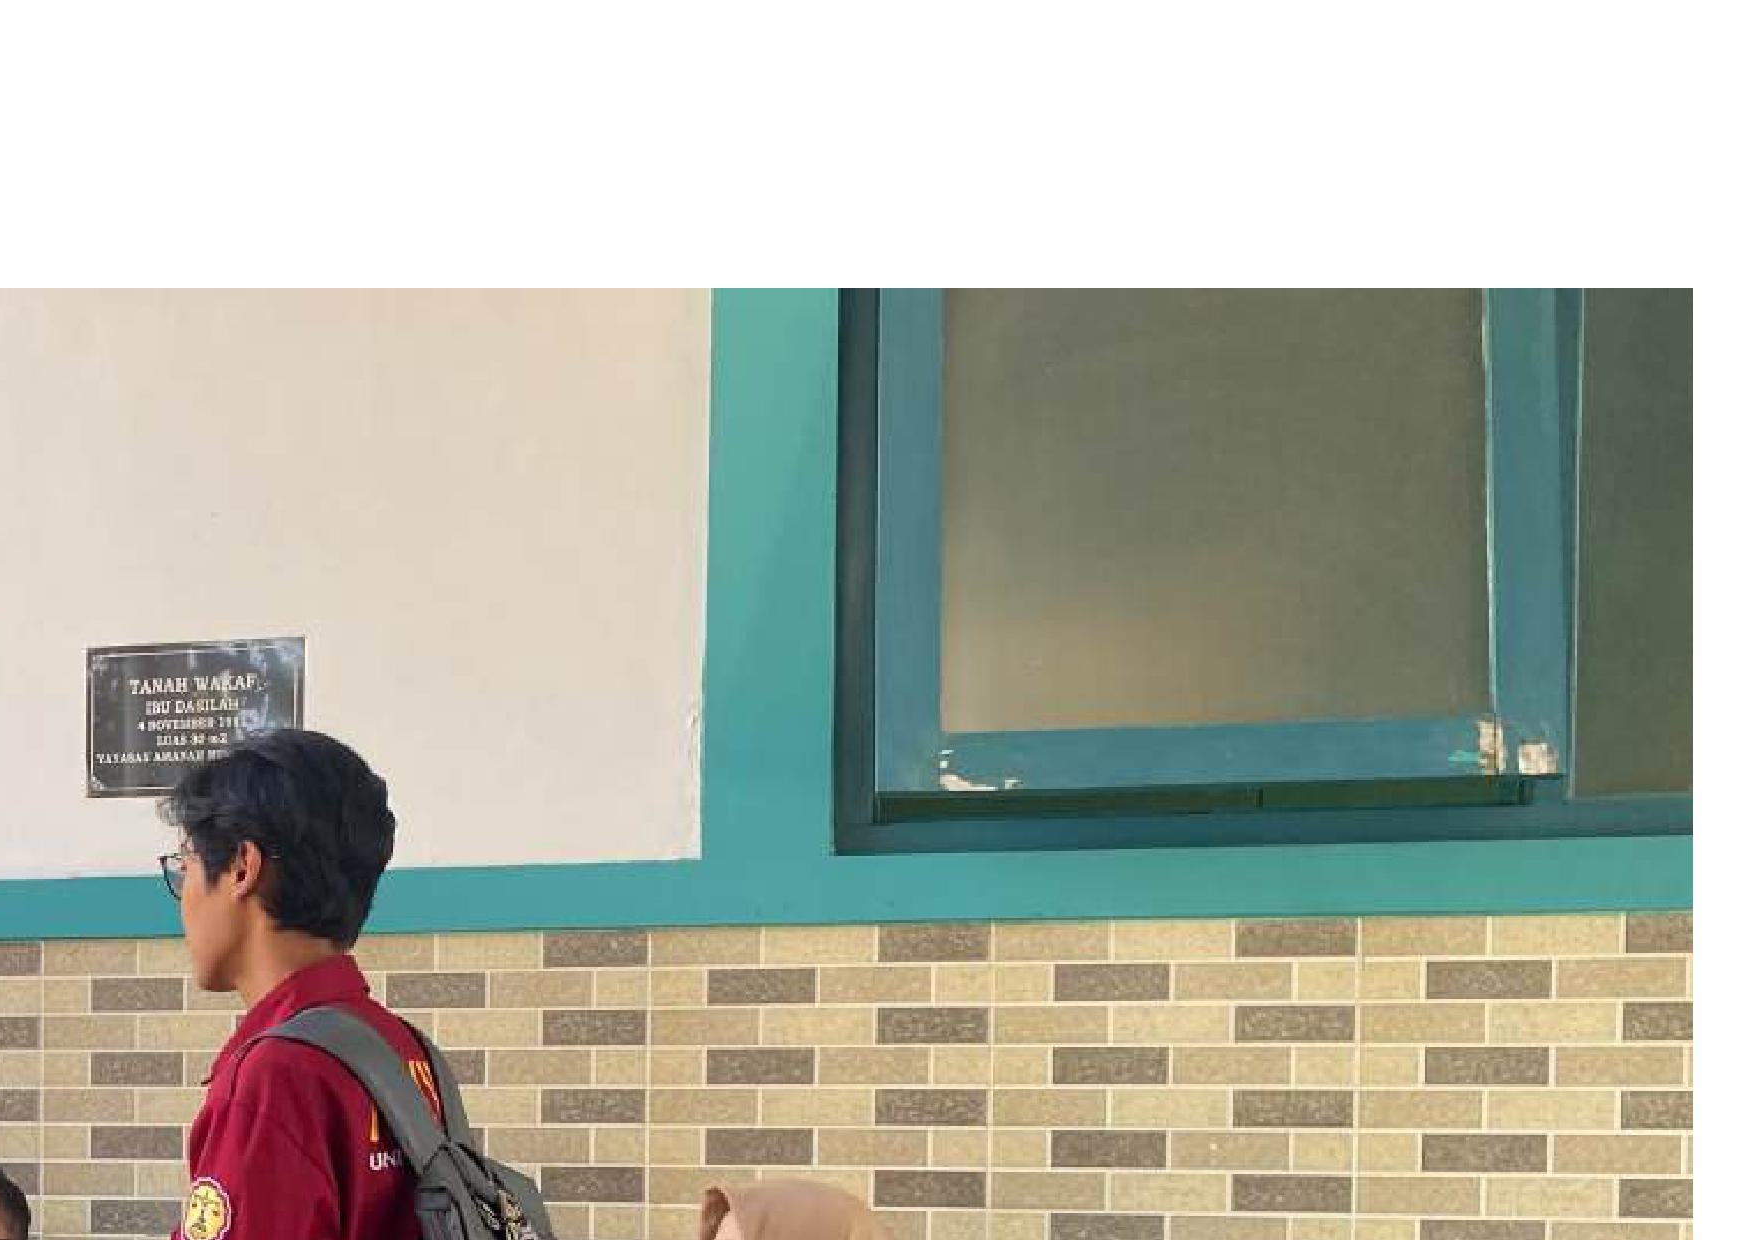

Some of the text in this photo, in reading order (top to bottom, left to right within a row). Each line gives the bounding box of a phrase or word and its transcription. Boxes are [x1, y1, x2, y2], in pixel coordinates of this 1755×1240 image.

[129, 675, 258, 695] TANAH WAKAF
[146, 700, 171, 716] IBU
[147, 717, 214, 732] NOVEMBER
